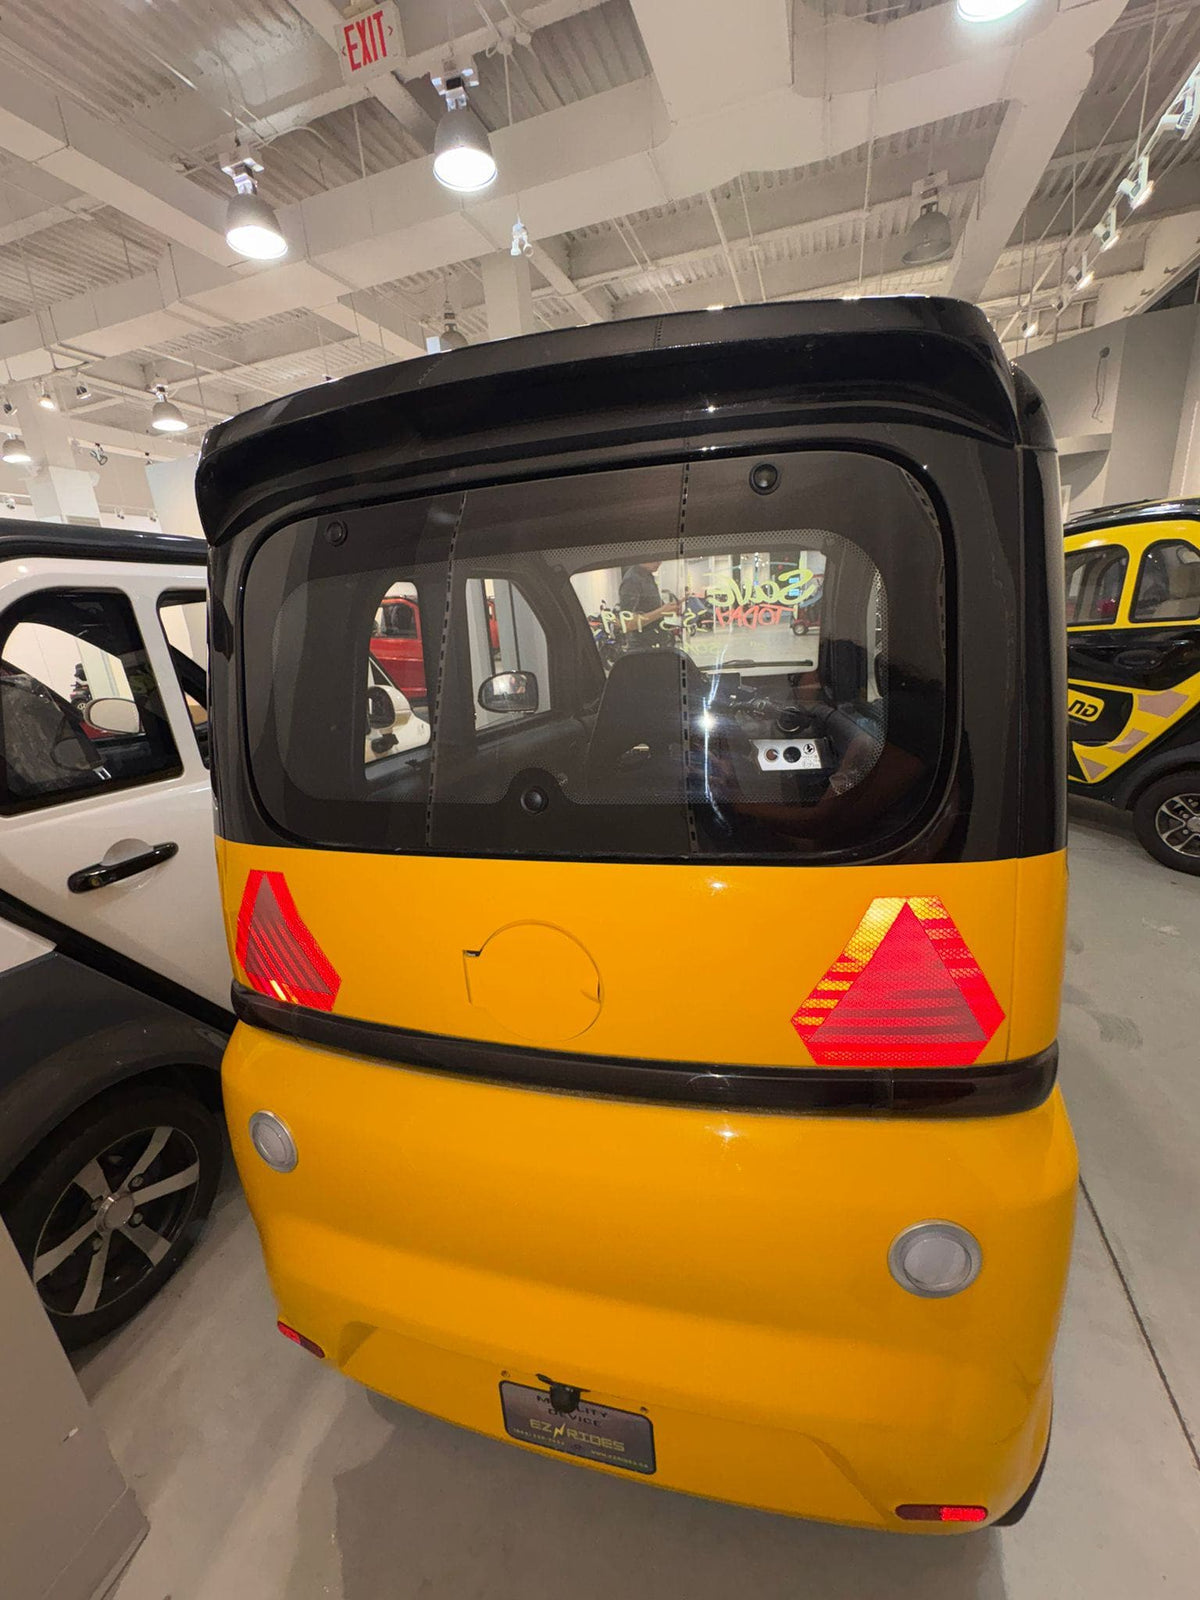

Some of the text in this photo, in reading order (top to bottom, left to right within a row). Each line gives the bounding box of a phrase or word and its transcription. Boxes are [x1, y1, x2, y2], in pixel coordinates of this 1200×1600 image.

[343, 10, 387, 71] EXIT
[537, 1395, 608, 1419] MLITY
[529, 1418, 552, 1433] EZ
[567, 1428, 625, 1452] RIDES
